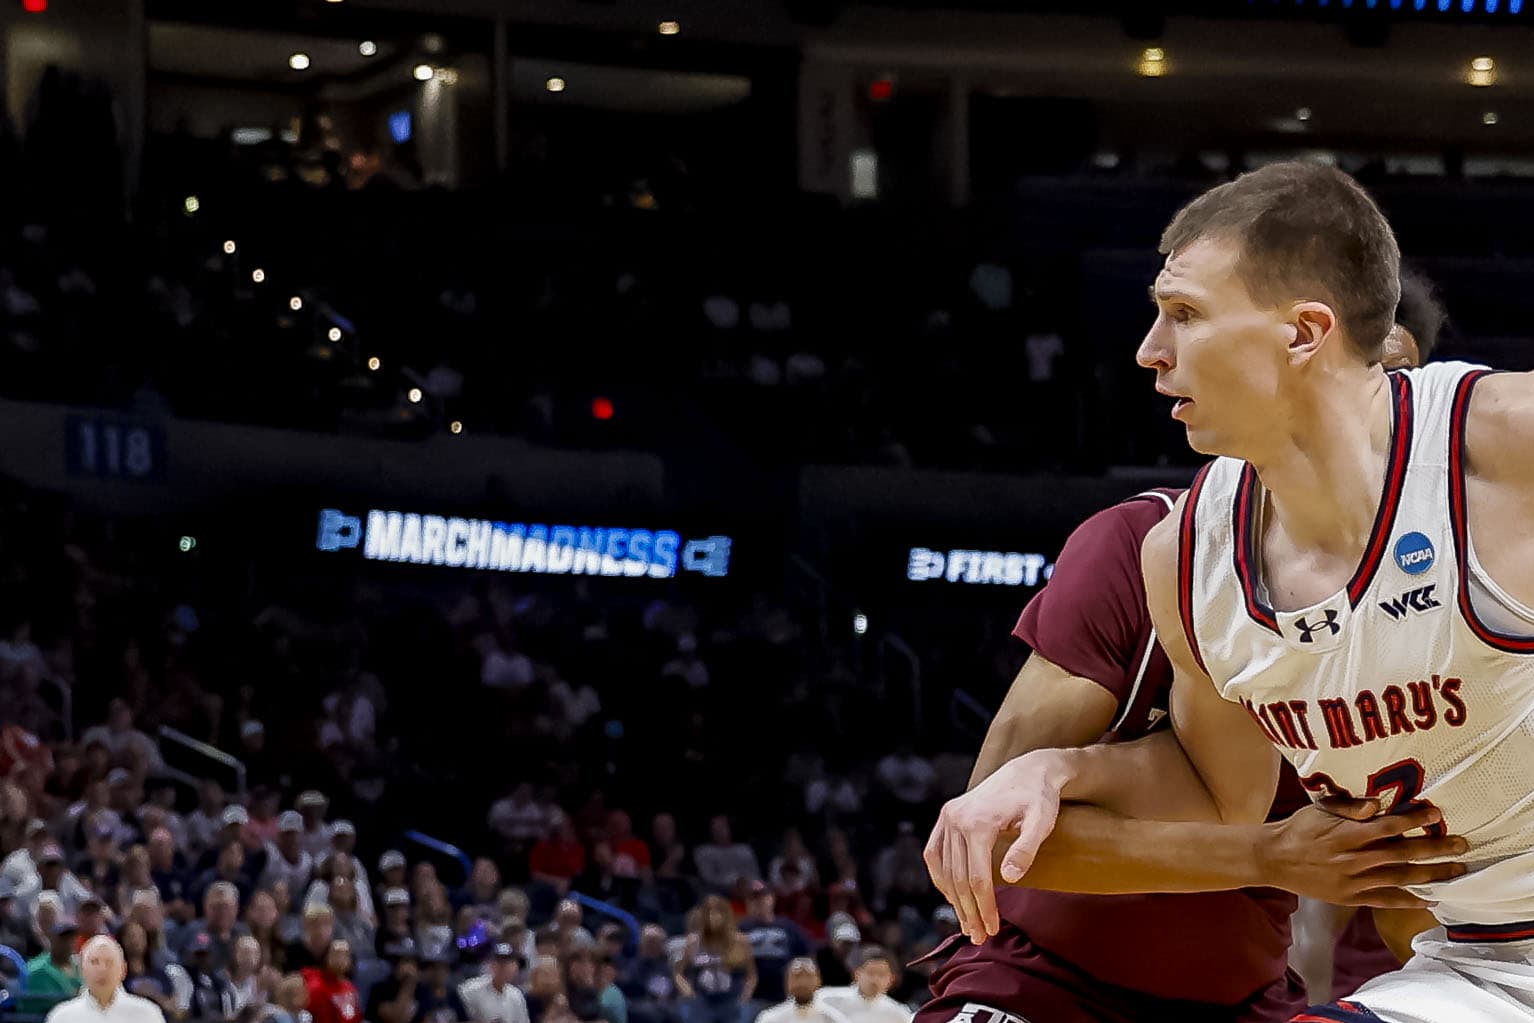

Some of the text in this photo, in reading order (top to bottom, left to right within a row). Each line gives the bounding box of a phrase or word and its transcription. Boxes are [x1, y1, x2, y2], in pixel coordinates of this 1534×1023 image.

[82, 424, 152, 475] 118
[946, 550, 1045, 586] FIRST
[1400, 547, 1433, 567] NCAA
[1379, 583, 1442, 619] WCC
[1318, 674, 1467, 749] MARY'S
